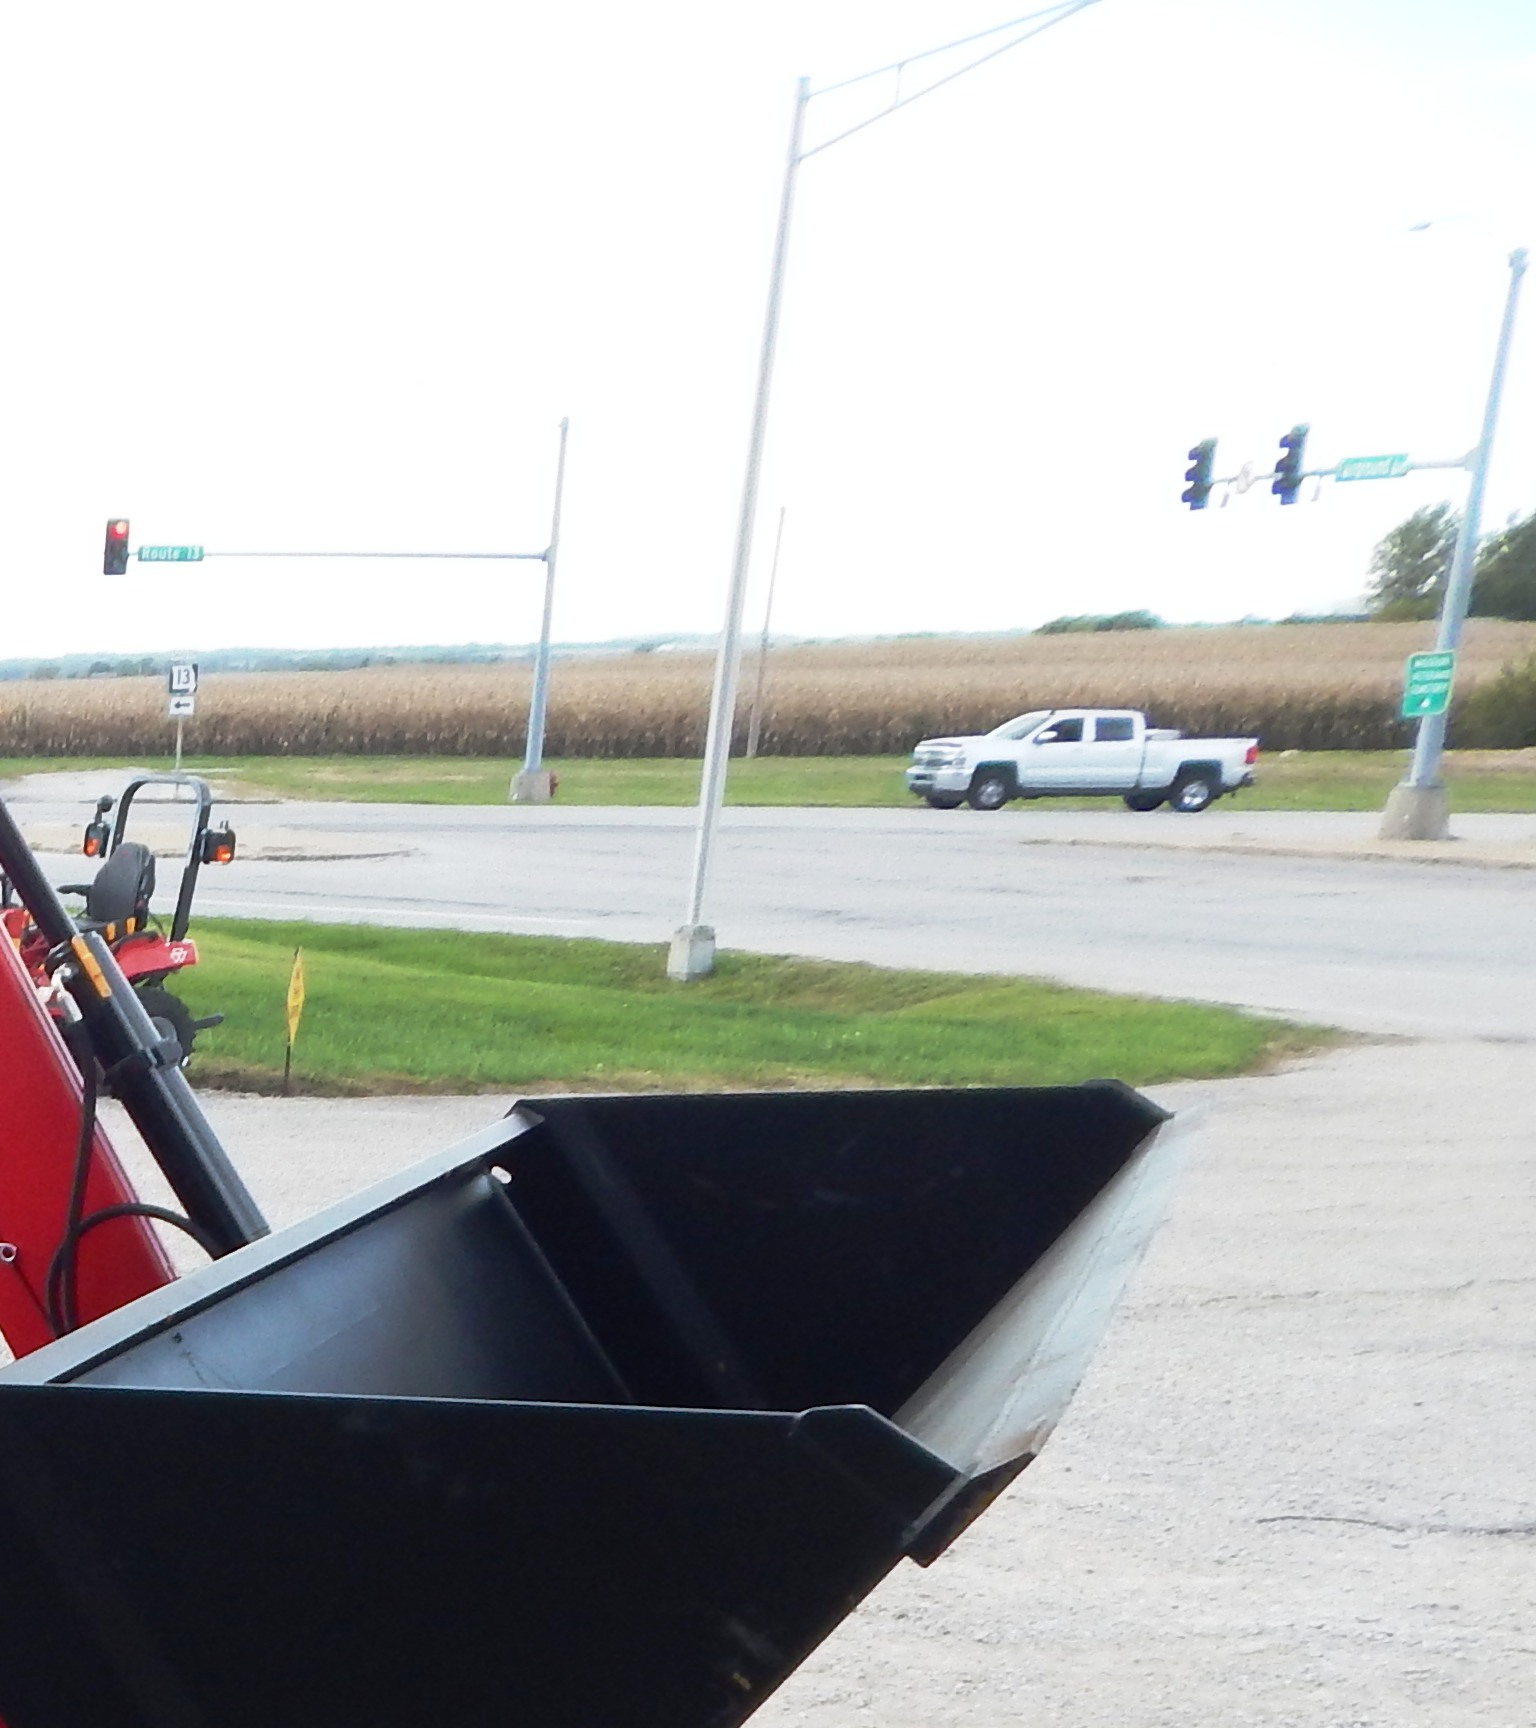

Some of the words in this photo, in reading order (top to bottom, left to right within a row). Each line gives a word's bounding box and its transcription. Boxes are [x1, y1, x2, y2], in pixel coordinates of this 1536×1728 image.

[141, 547, 181, 560] Route
[186, 547, 200, 560] 13
[177, 668, 191, 685] 13
